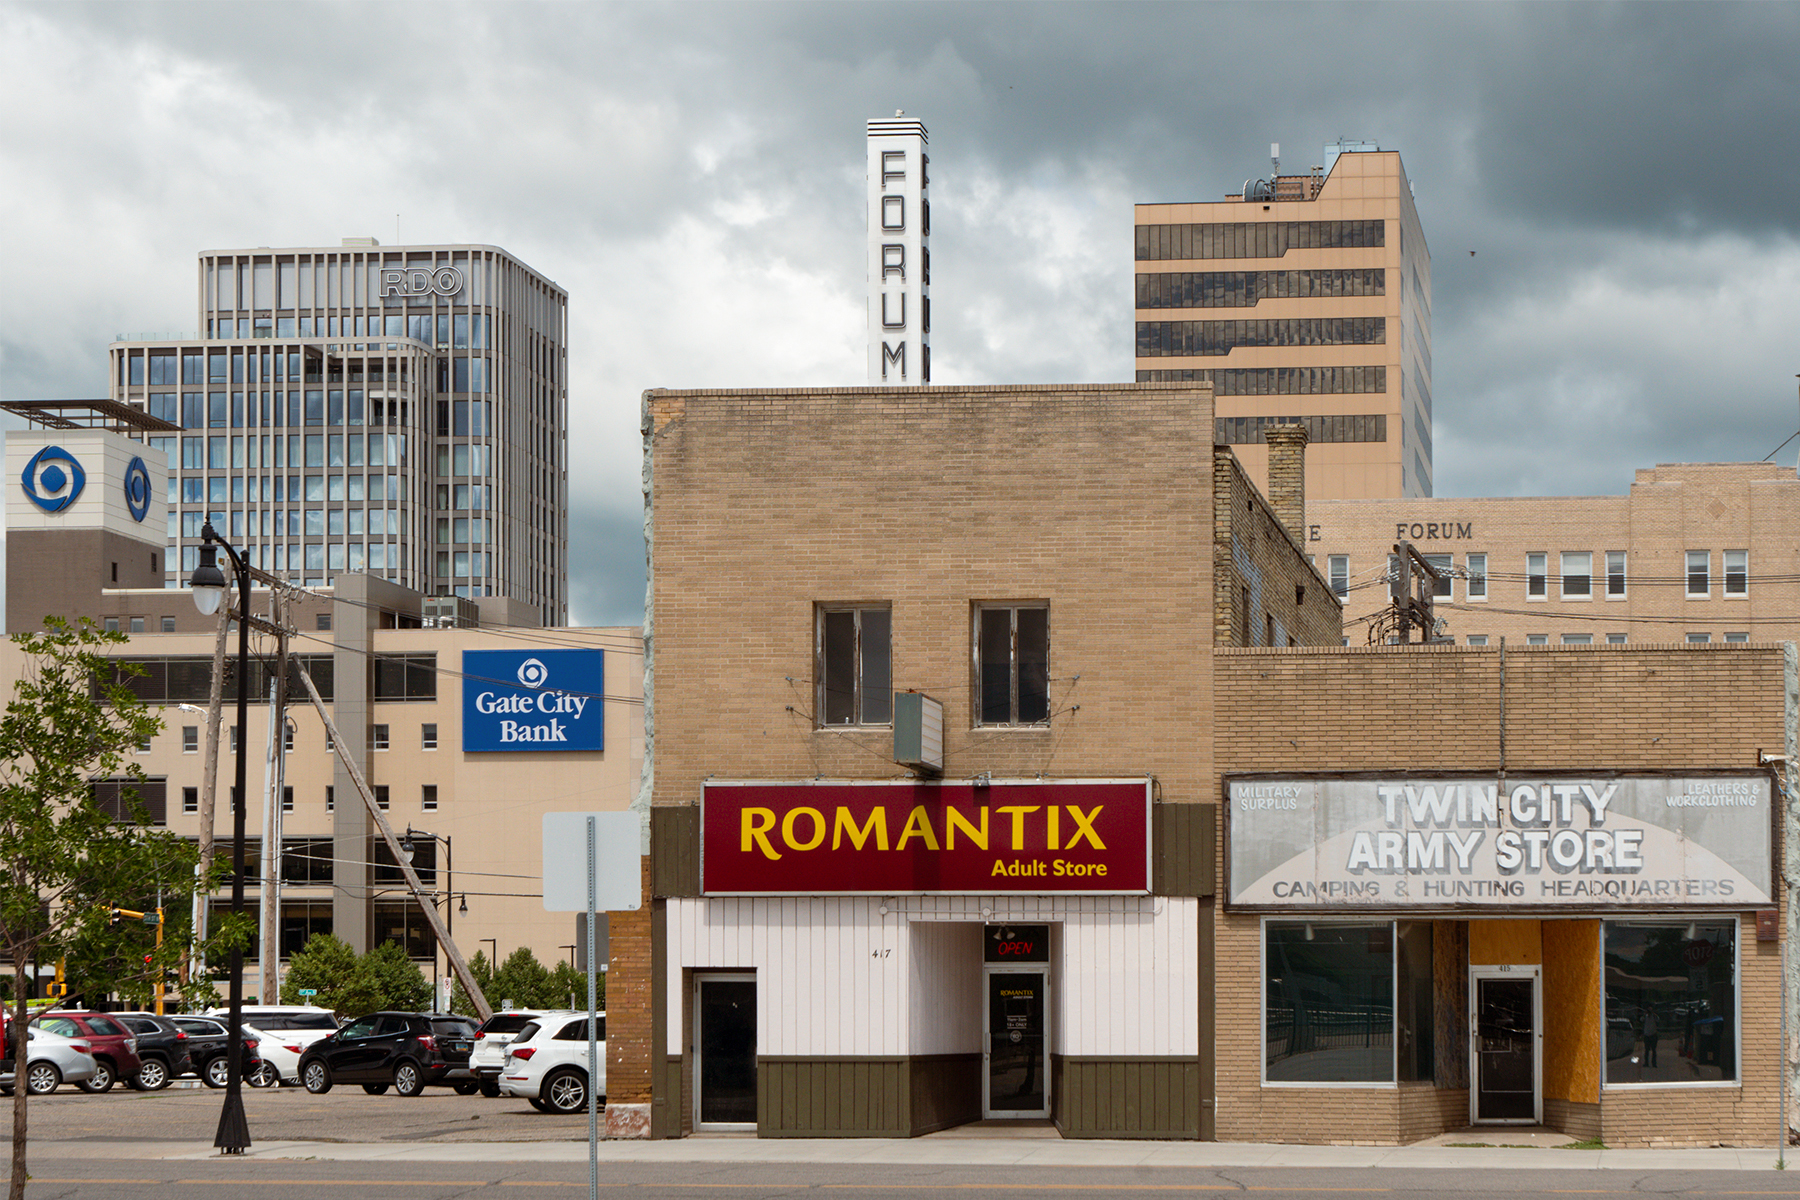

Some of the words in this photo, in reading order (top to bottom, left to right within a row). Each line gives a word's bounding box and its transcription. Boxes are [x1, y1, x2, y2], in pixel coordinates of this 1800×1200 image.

[881, 150, 906, 378] FORUM
[379, 265, 464, 297] RDO
[1396, 522, 1472, 539] FORUM
[475, 691, 534, 714] Gate
[537, 690, 589, 720] City
[500, 718, 568, 742] Bank
[1238, 786, 1302, 798] MILITARY
[1688, 783, 1749, 795] LEATHERS
[1752, 784, 1761, 794] &
[1240, 798, 1297, 811] SURPLUS
[1377, 784, 1499, 828] TWIN
[1510, 784, 1618, 828] CITY
[1666, 796, 1757, 808] WORKCLOTHING
[740, 804, 1107, 861] ROMANTIX
[1345, 830, 1486, 875] ARMY
[1496, 829, 1644, 876] STORE
[990, 859, 1047, 877] Adult
[1052, 858, 1108, 877] Store
[1272, 881, 1380, 898] CAMPING
[1394, 880, 1410, 897] &
[1423, 880, 1525, 897] HUNTING
[1540, 879, 1735, 898] HEADQUARTERS
[871, 948, 891, 959] 417
[998, 941, 1033, 955] OPEN
[1000, 989, 1033, 997] ROMANTIX
